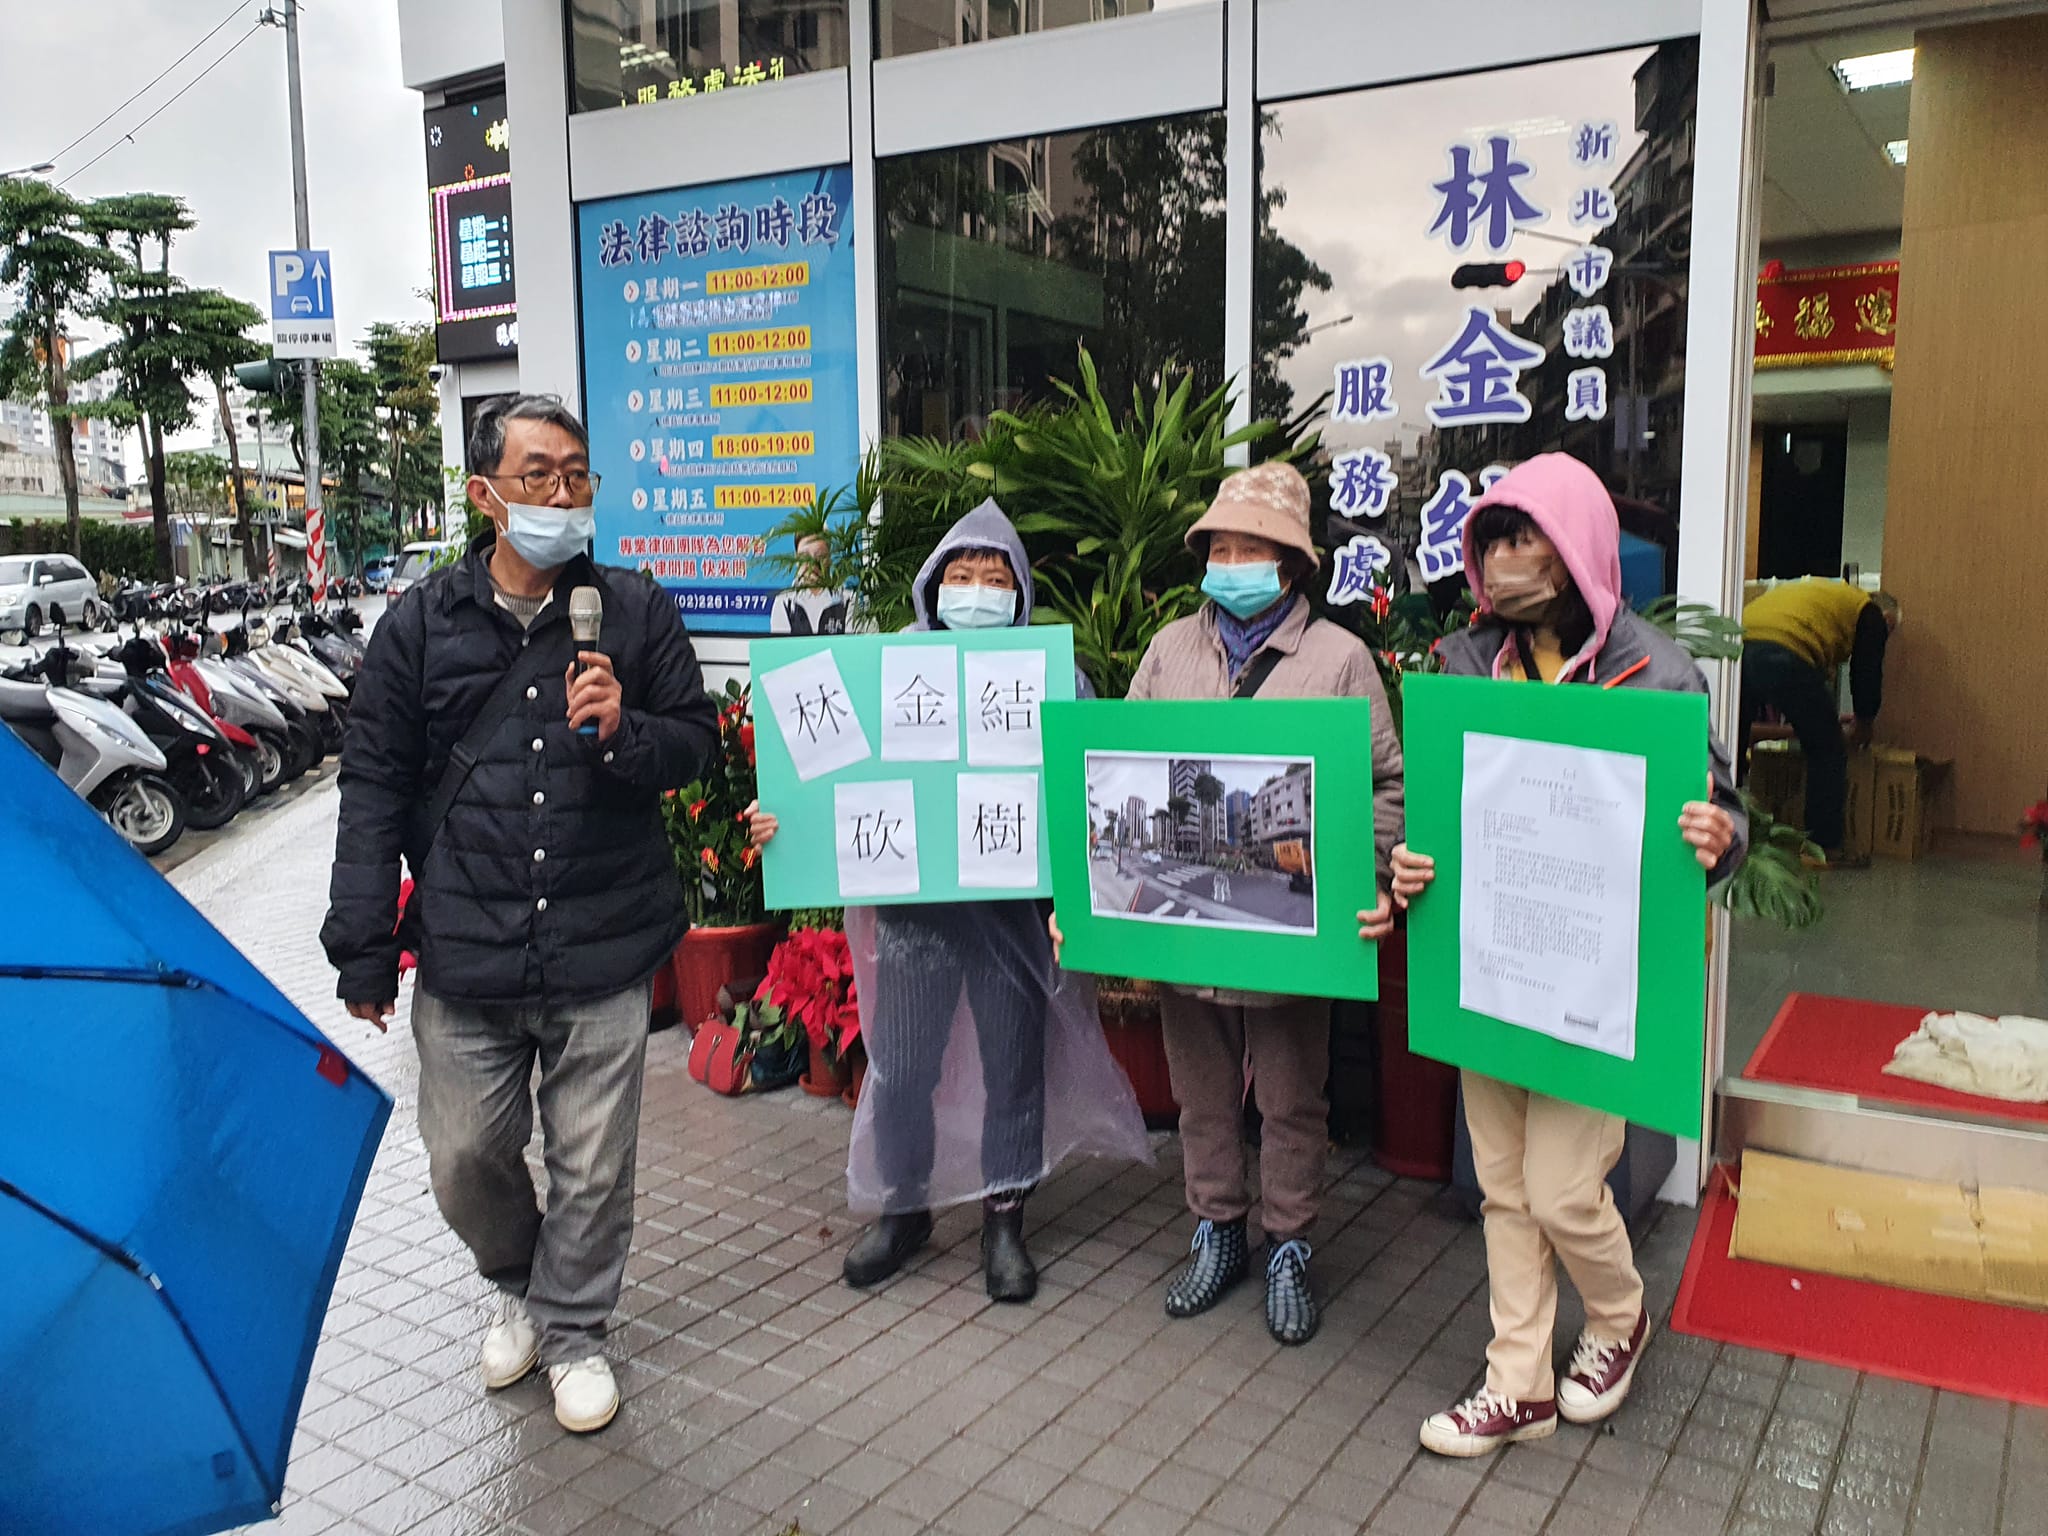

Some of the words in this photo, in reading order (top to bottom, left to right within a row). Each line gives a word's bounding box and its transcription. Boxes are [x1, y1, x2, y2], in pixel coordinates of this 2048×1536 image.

[600, 193, 839, 266] 法律諮詢時段
[275, 255, 304, 296] P
[645, 277, 699, 303] 星期一
[712, 266, 804, 291] 11:00-12:00
[1566, 120, 1615, 420] 新北市議員
[647, 337, 701, 363] 星期二
[714, 329, 806, 353] 11:00-12:00
[649, 387, 703, 413] 星期三
[716, 383, 808, 404] 11:00-12:00
[651, 437, 705, 463] 星期四
[718, 435, 810, 455] 18:00-19:00
[653, 486, 708, 512] 星期五
[720, 487, 812, 505] 11:00-12:00
[1331, 360, 1395, 603] 服務處
